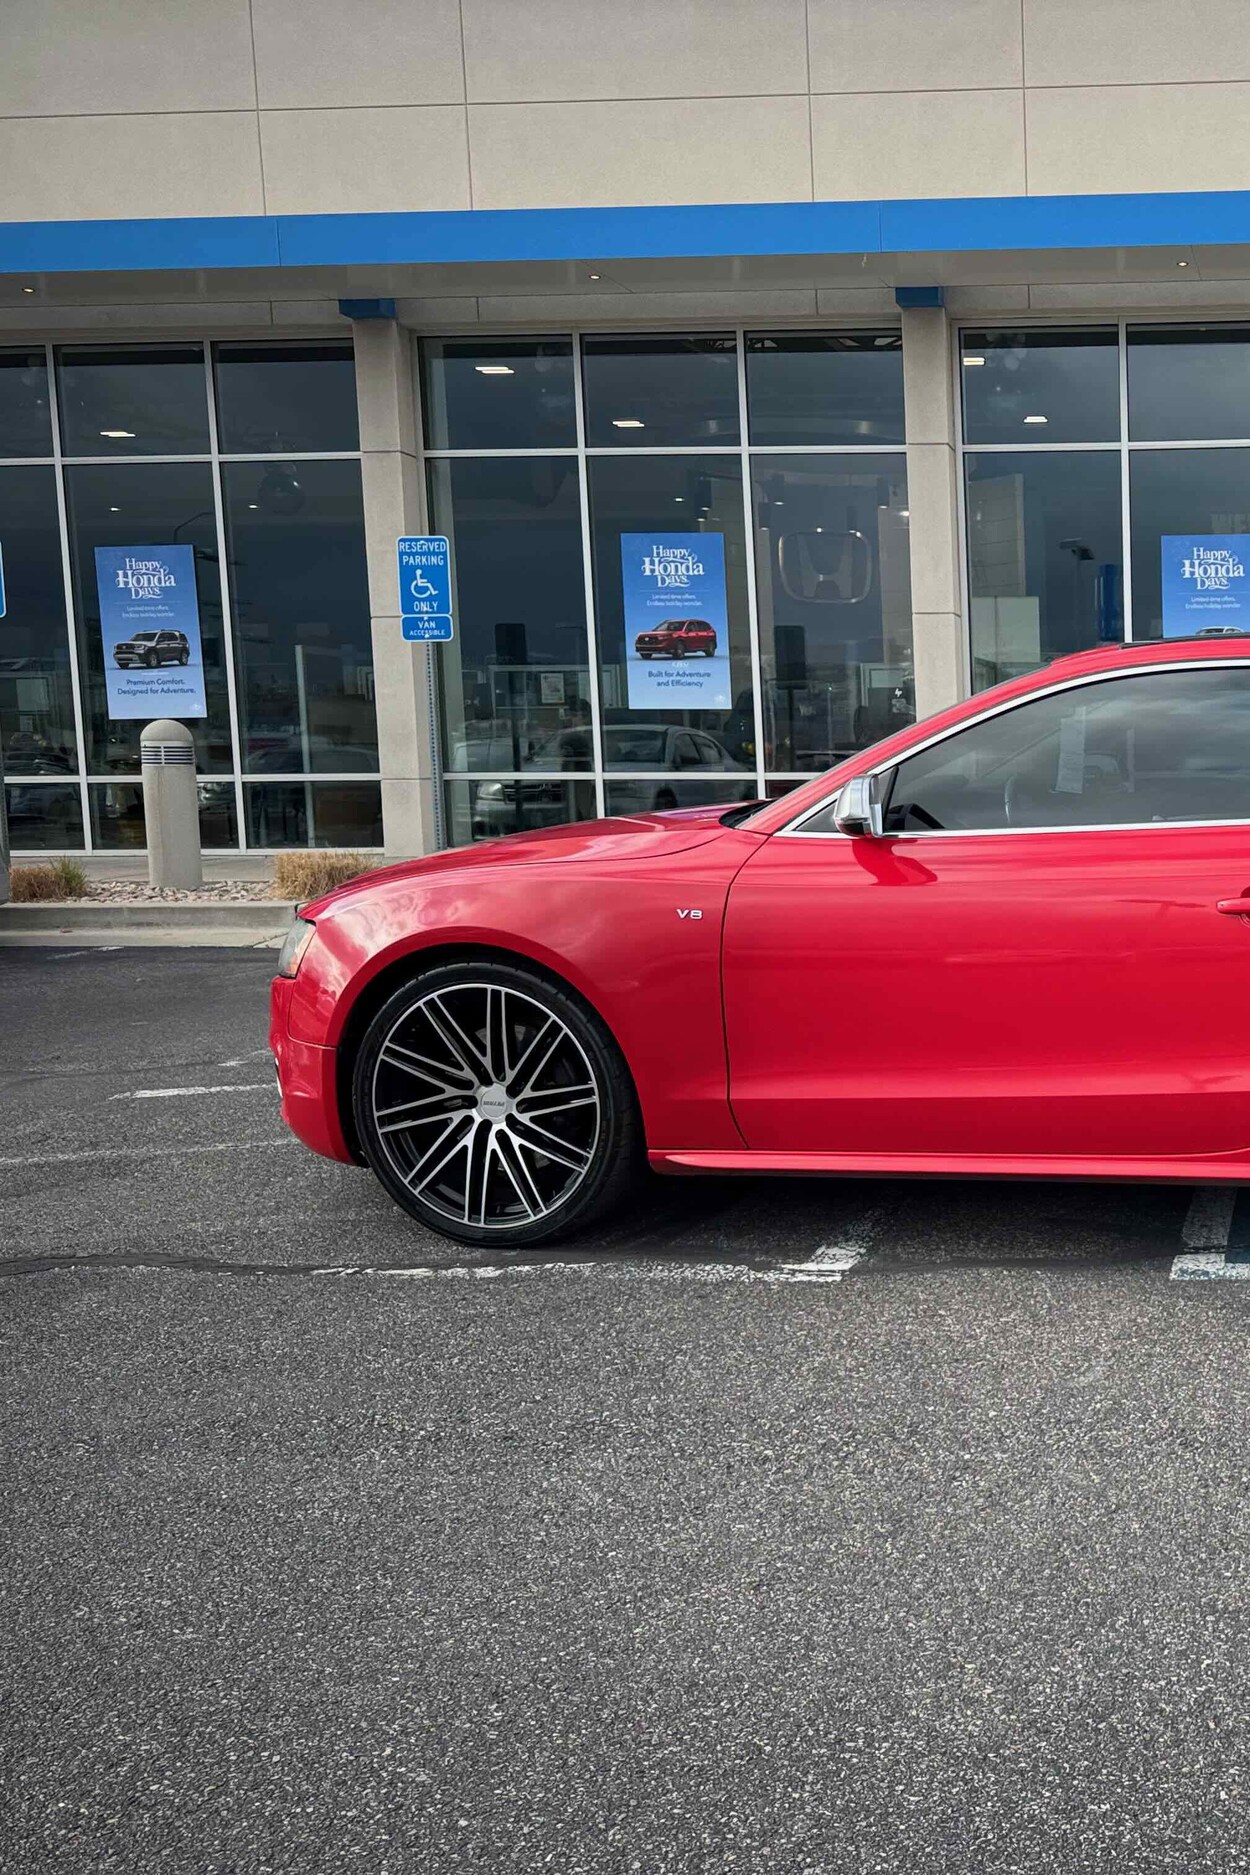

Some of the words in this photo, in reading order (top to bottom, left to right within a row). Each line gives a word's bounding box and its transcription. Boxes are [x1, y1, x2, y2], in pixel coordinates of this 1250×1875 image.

[399, 541, 446, 553] RESERVED
[652, 545, 690, 562] Happy
[1193, 547, 1232, 564] Happy
[125, 558, 162, 574] Happy
[403, 555, 444, 566] PARKING
[641, 554, 705, 576] Honda
[1181, 556, 1245, 579] Honda
[115, 566, 176, 588] Honda
[657, 575, 691, 588] Days
[1197, 577, 1230, 590] Days
[131, 587, 163, 599] Days
[414, 601, 438, 612] ONLY
[418, 621, 436, 629] VAN
[671, 680, 703, 688] Efficiency
[118, 688, 148, 696] Designed
[676, 908, 702, 920] V8
